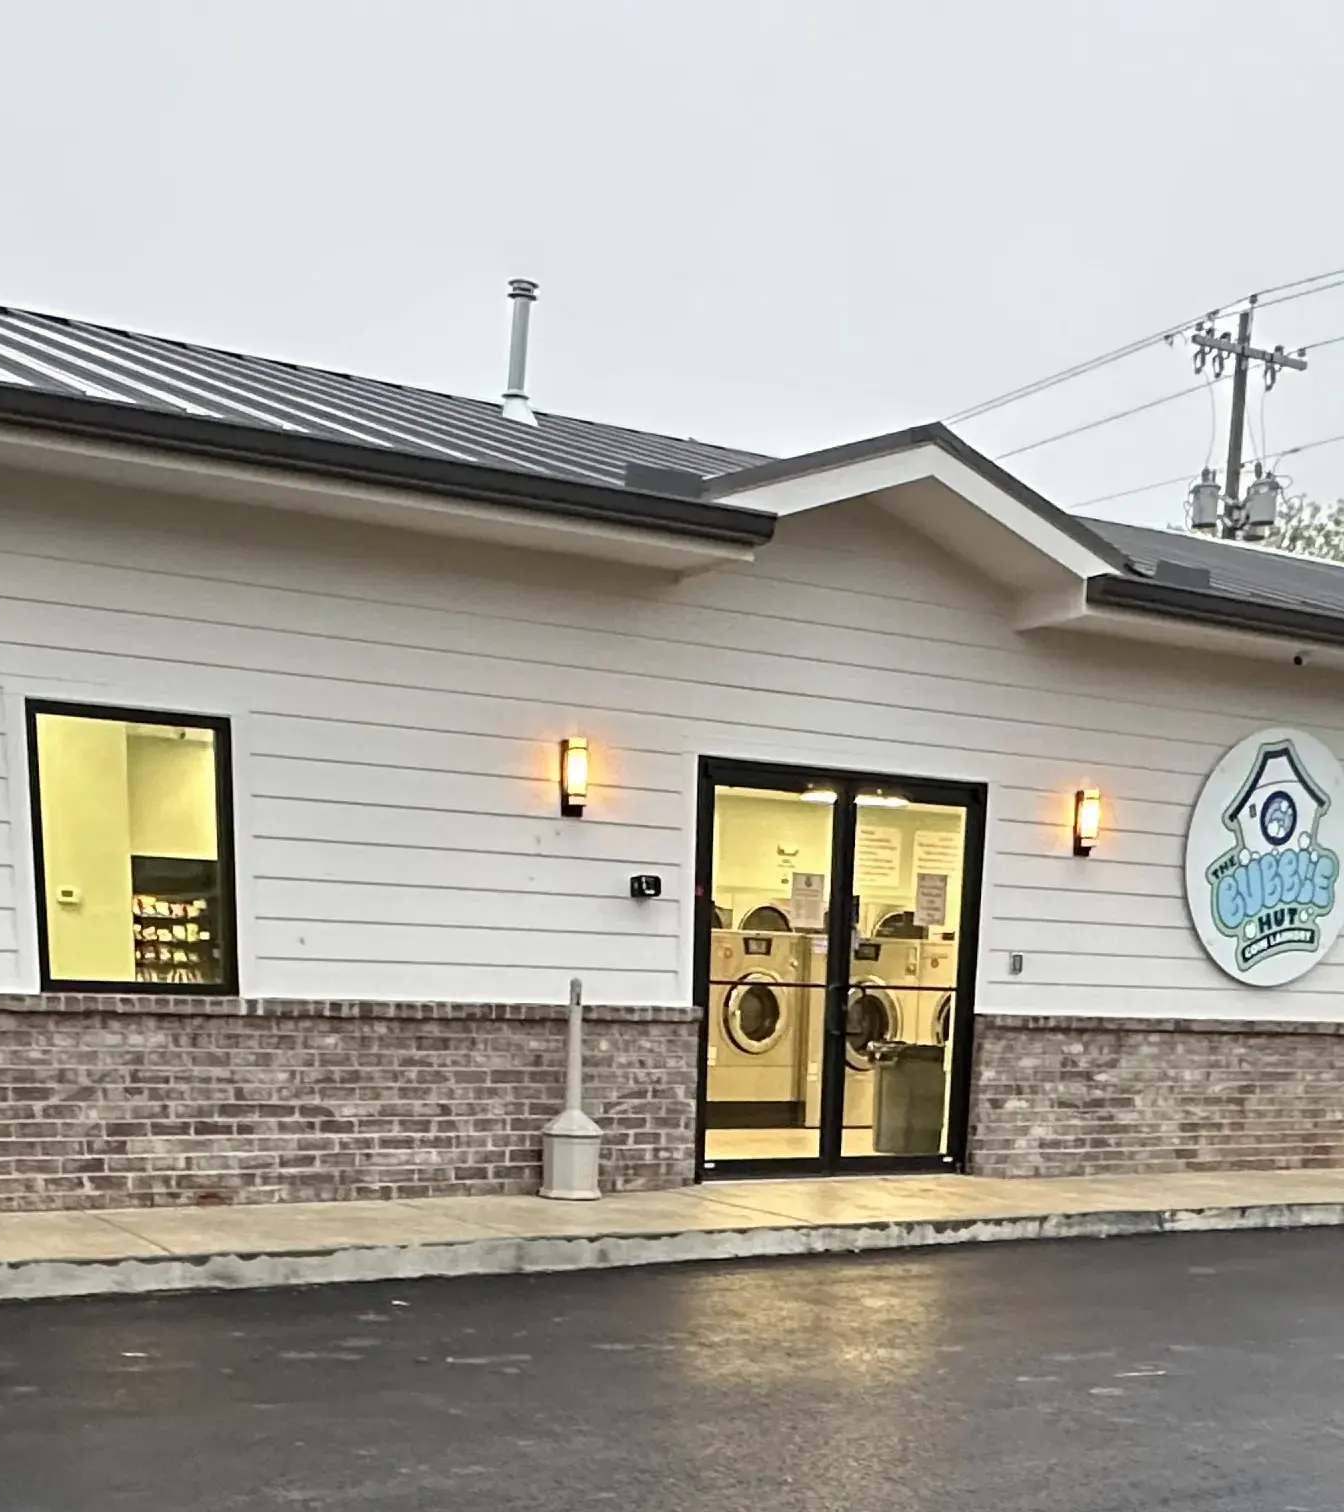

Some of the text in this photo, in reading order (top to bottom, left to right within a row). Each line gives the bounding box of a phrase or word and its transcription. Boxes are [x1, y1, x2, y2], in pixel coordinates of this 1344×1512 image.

[1211, 855, 1236, 880] THE
[1217, 848, 1336, 930] BUBBLE
[1257, 907, 1298, 934] HUT
